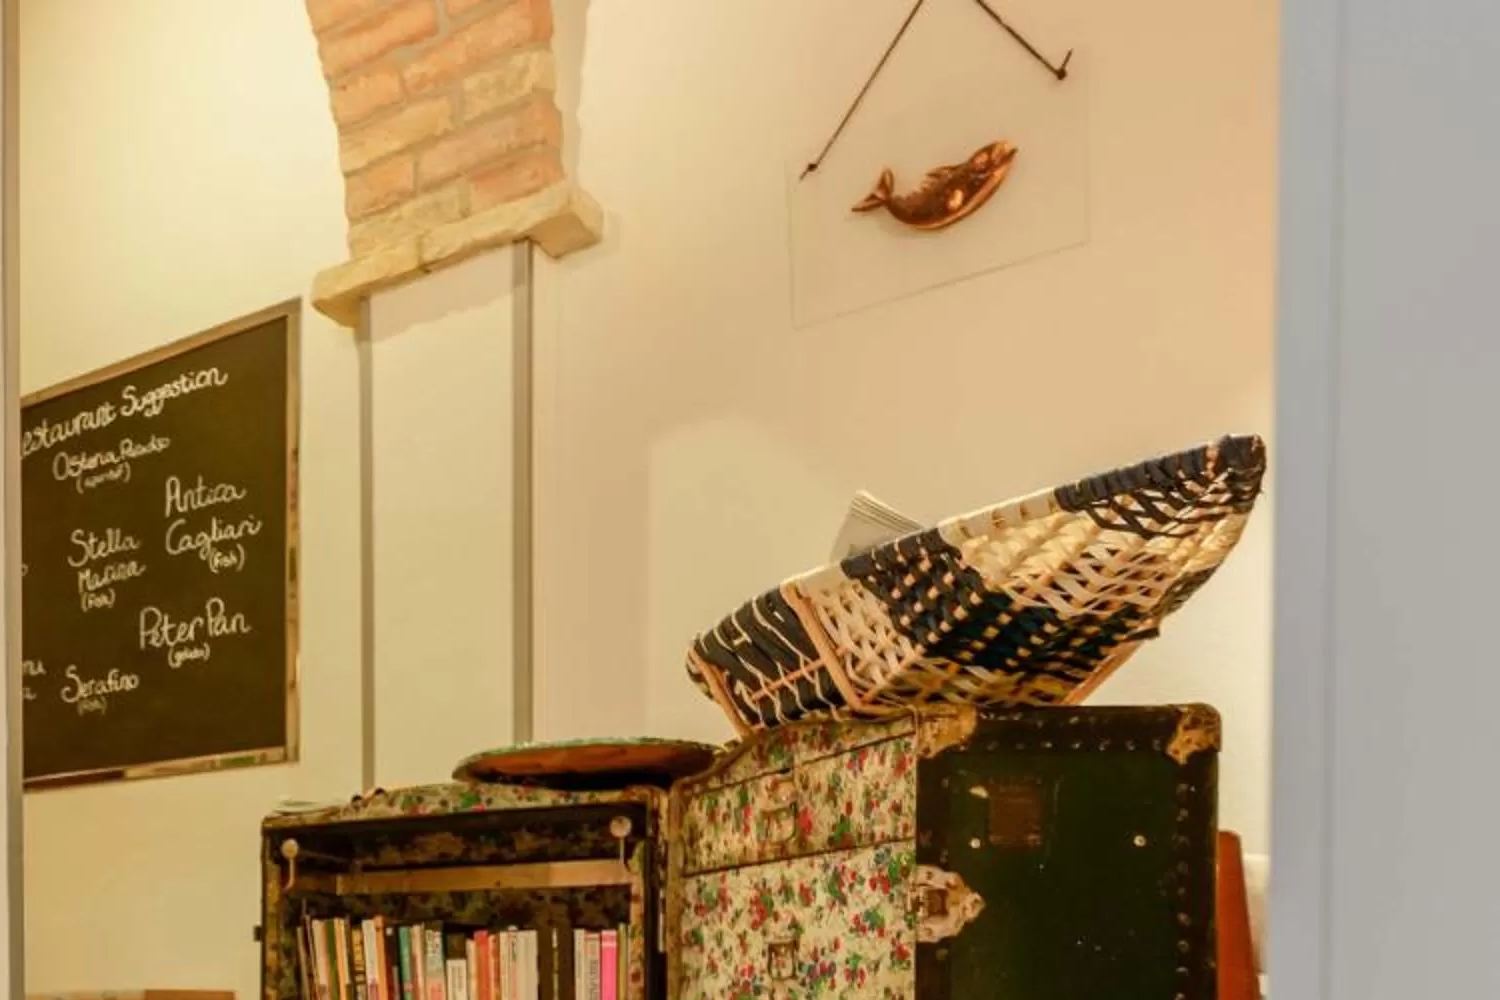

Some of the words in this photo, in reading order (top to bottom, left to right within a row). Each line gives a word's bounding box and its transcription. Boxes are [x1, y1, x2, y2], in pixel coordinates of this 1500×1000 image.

[20, 401, 117, 459] estaurant
[120, 367, 228, 417] Suggestion
[165, 475, 247, 518] Antica
[68, 528, 140, 567] Stella
[165, 514, 262, 560] Cagliari
[139, 605, 204, 650] Peter
[205, 597, 251, 637] Pan
[61, 664, 140, 704] Serafino
